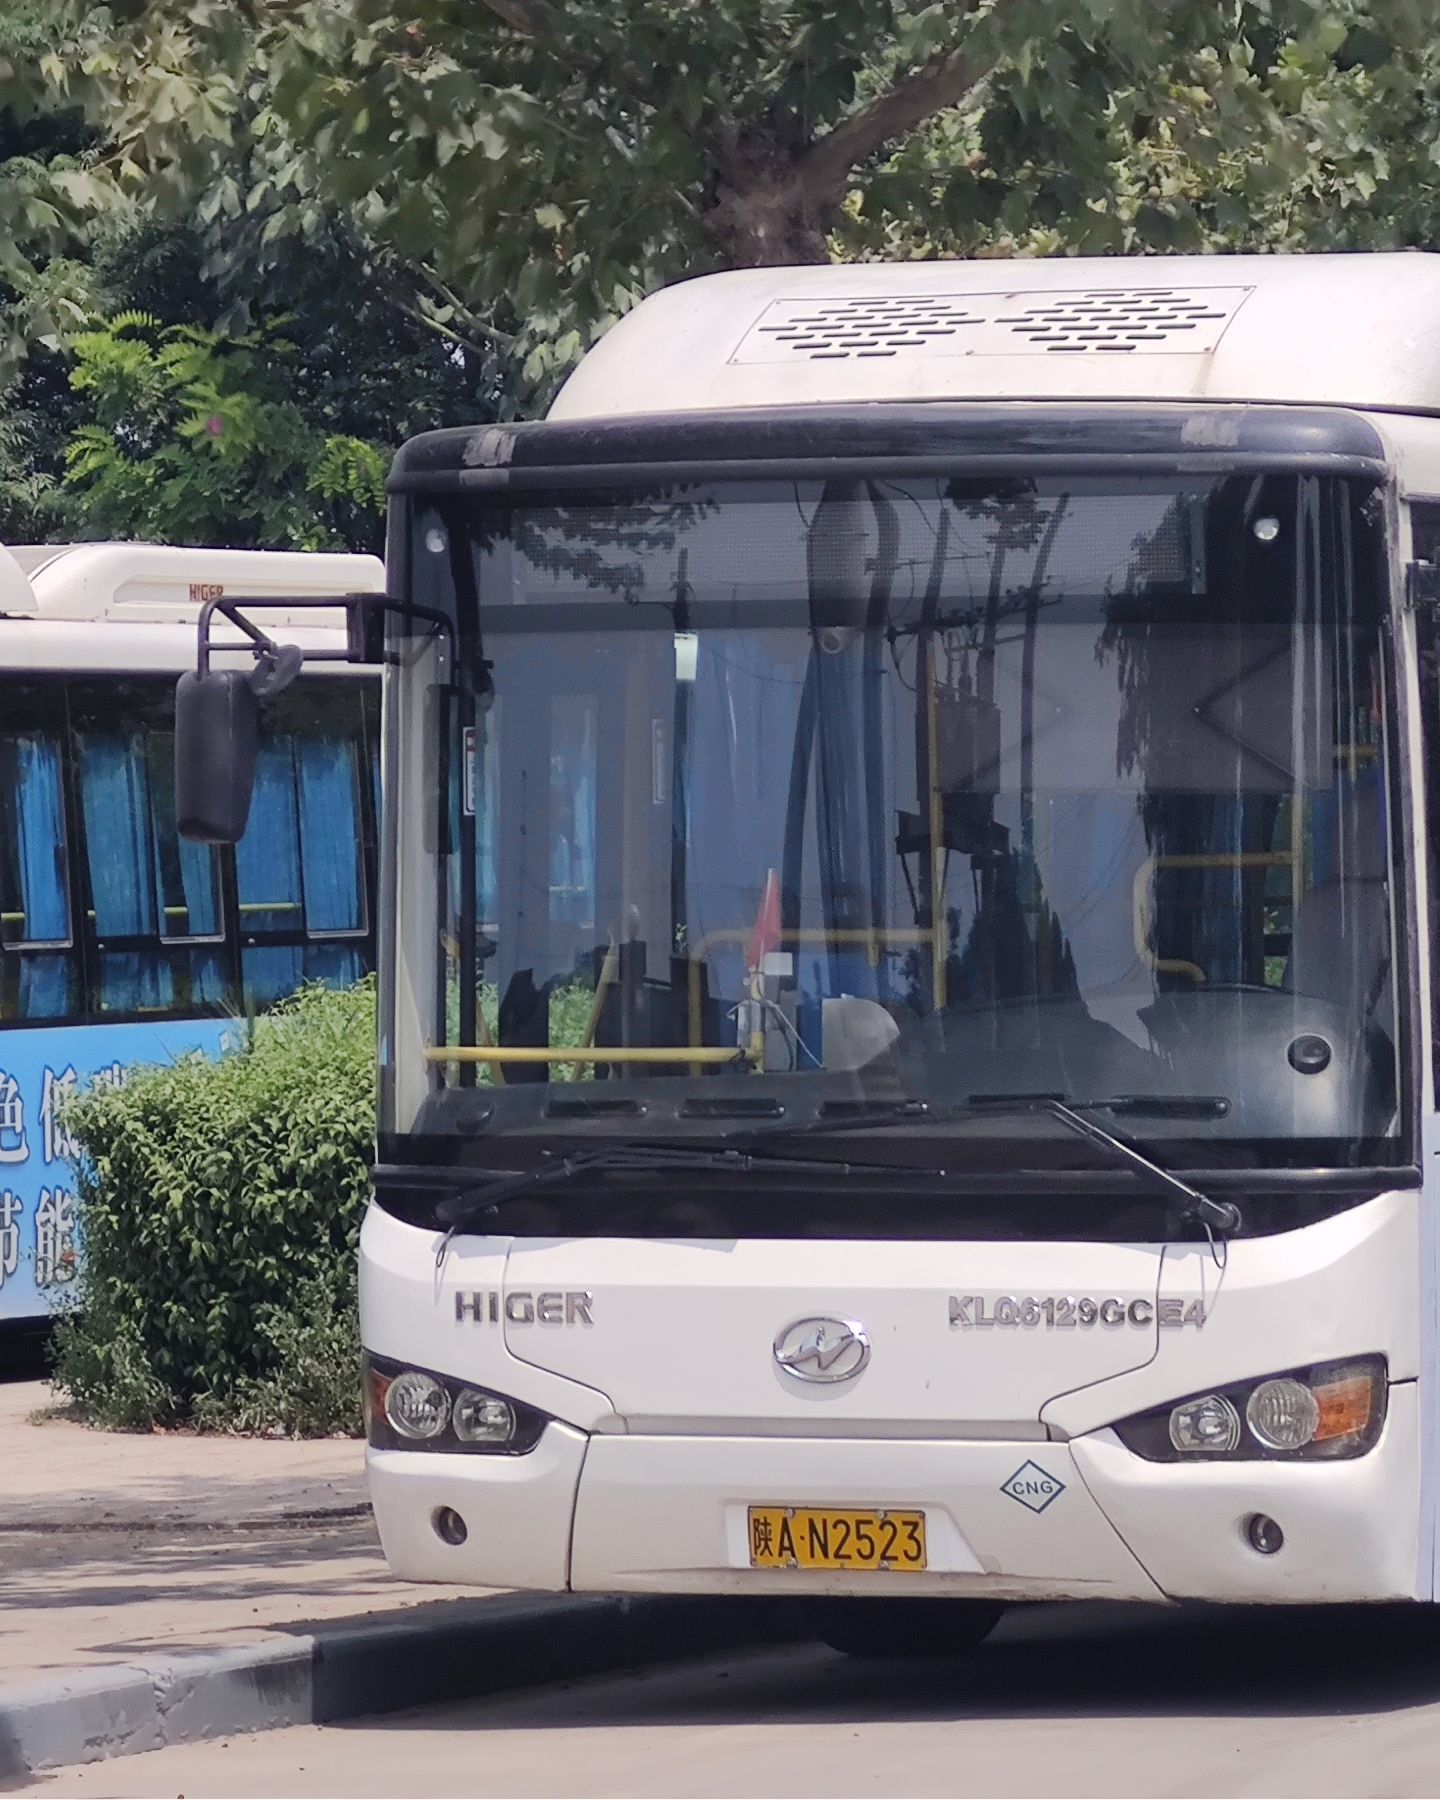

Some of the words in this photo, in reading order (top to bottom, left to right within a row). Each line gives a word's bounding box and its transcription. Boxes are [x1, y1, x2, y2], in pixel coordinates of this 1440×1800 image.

[189, 583, 224, 602] HIGER
[454, 1290, 595, 1325] HIGER
[948, 1295, 1208, 1330] KLQ6129GCE4
[1011, 1480, 1054, 1496] CNG
